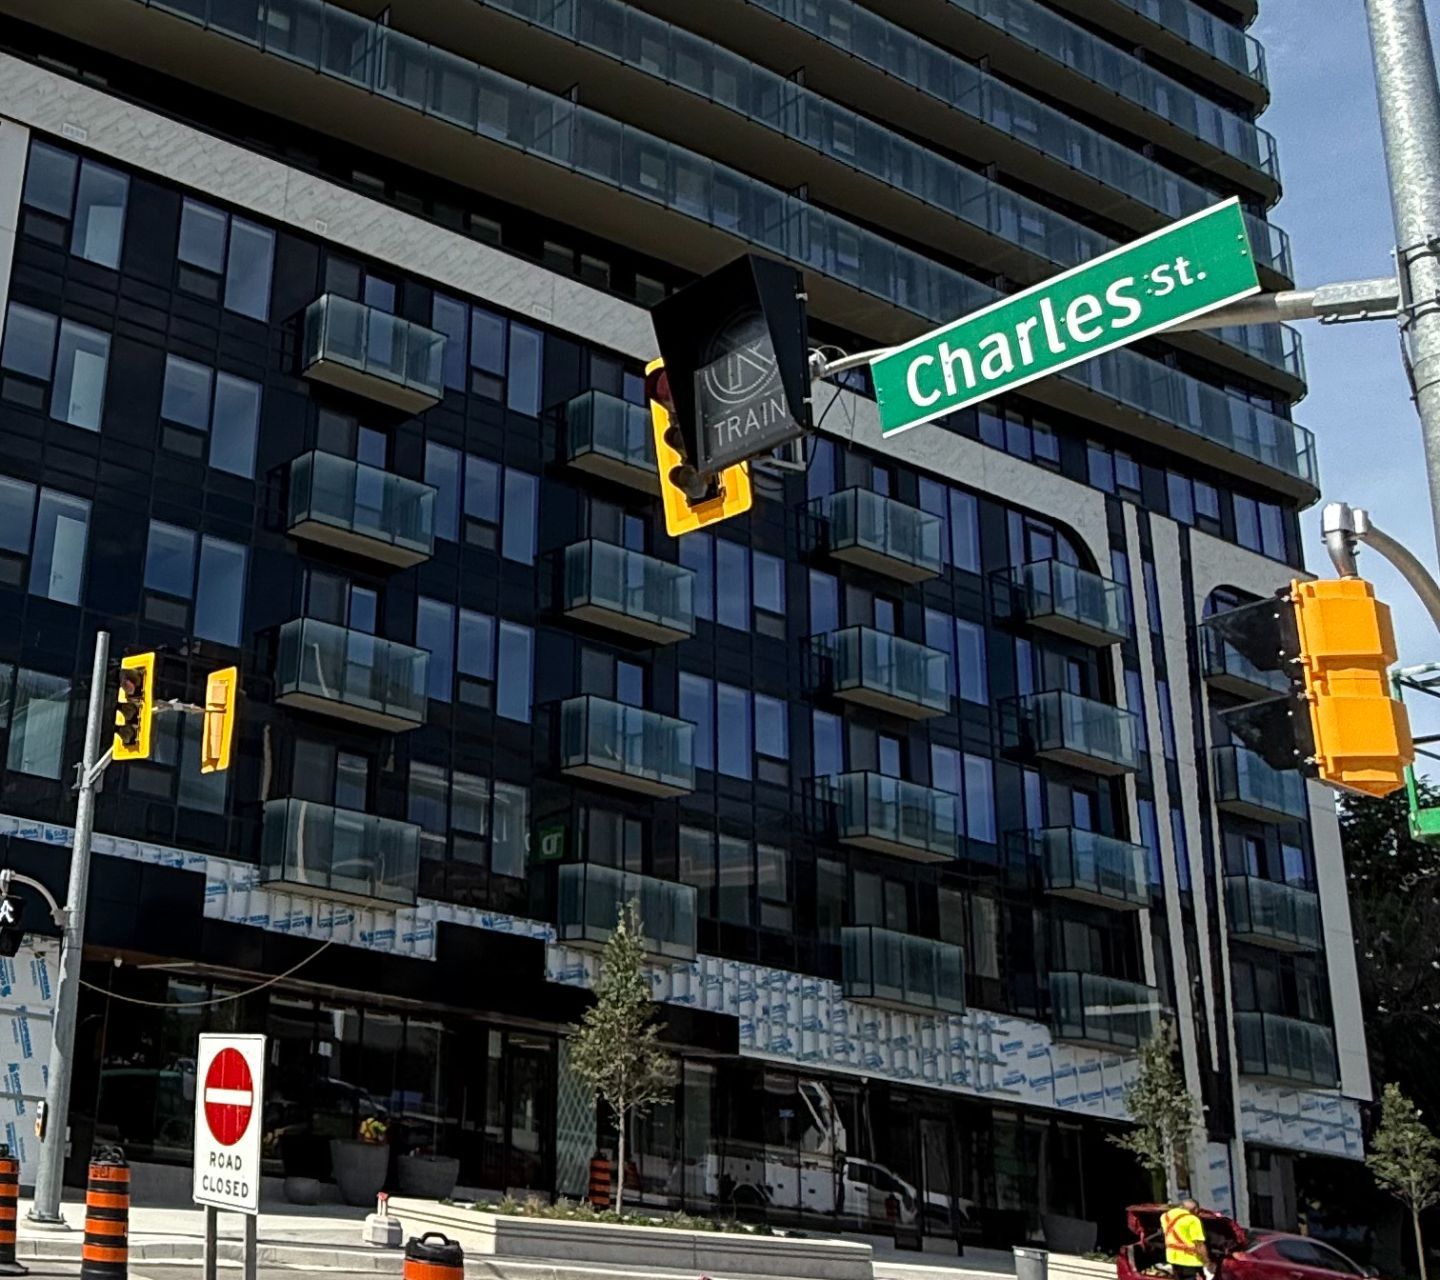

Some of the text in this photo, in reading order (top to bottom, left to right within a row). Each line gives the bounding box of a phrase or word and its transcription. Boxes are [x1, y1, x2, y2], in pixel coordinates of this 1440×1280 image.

[906, 276, 1143, 408] Charles
[713, 392, 786, 447] TRAIN
[209, 1151, 242, 1171] ROAD
[202, 1175, 249, 1198] CLOSED
